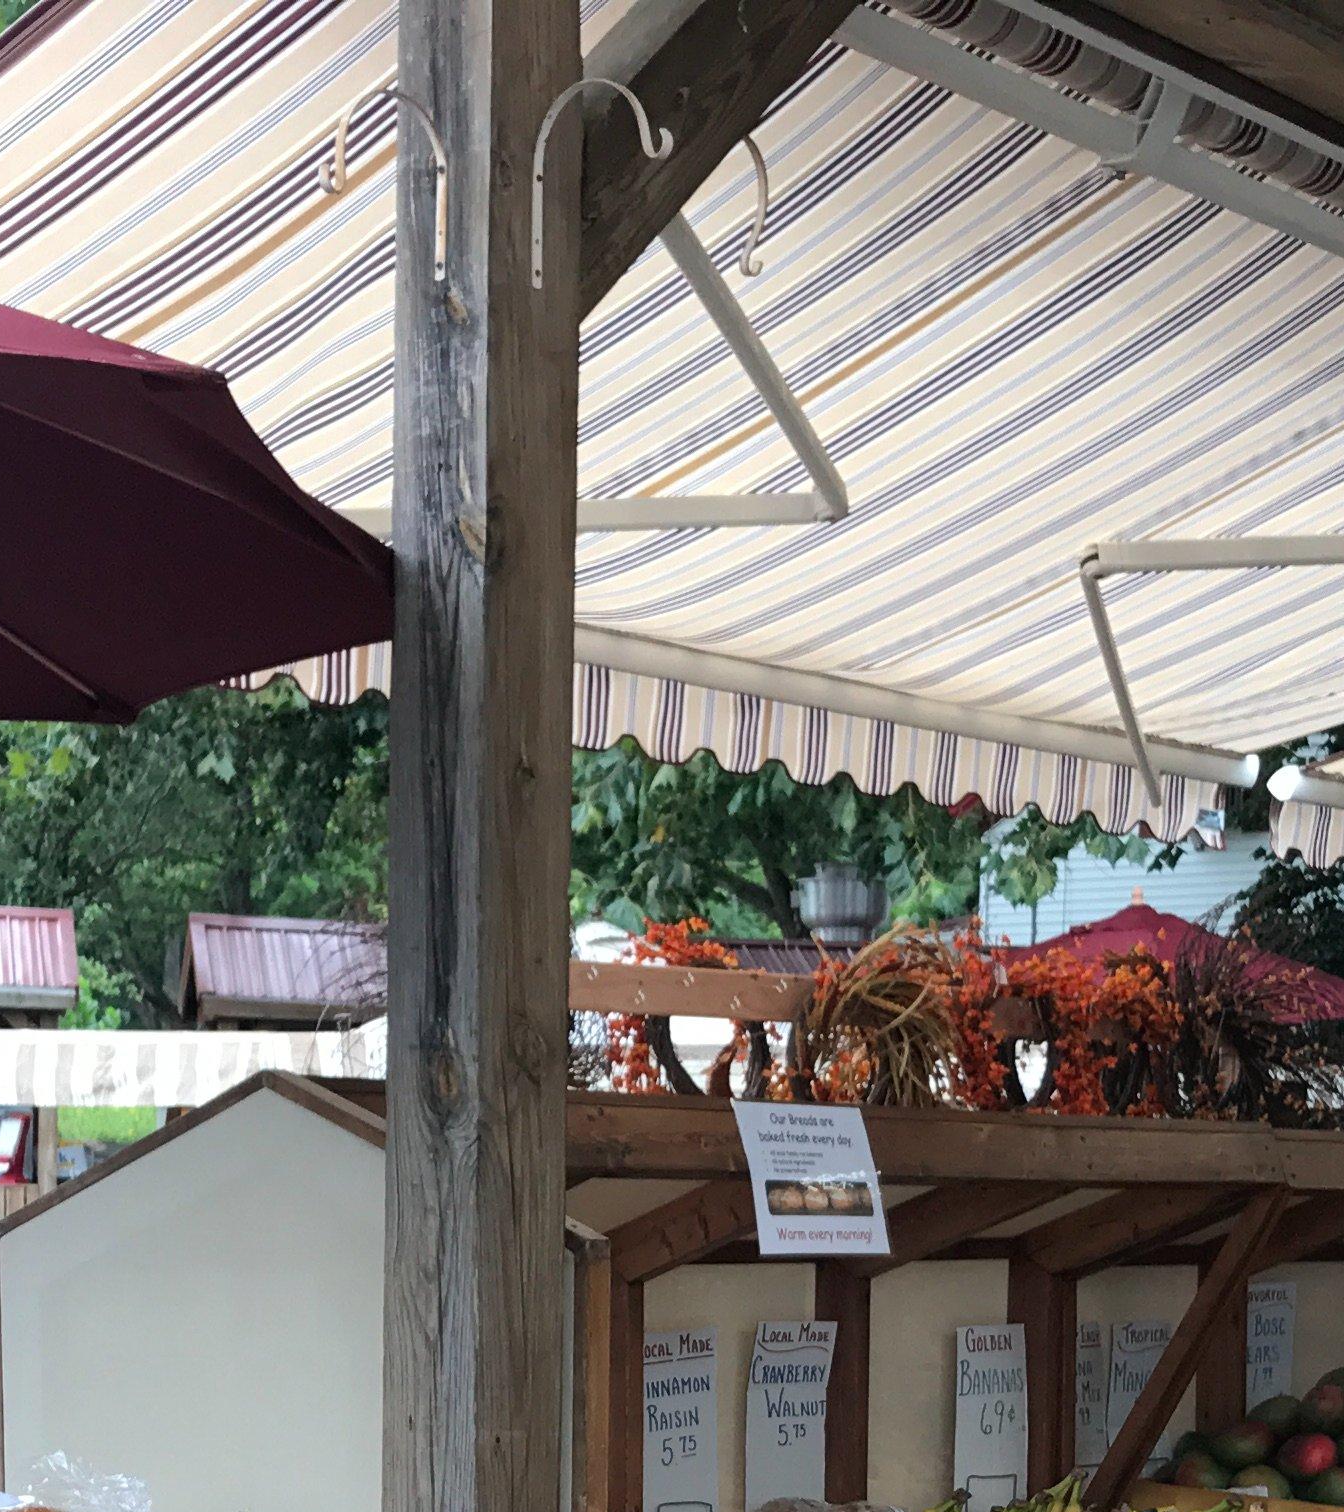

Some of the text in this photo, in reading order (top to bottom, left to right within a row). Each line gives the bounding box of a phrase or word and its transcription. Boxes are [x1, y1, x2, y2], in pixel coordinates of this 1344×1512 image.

[788, 1112, 817, 1126] Breads
[819, 1117, 834, 1127] are
[758, 1129, 785, 1143] baked
[787, 1130, 810, 1143] fresh
[812, 1135, 835, 1147] every
[776, 1226, 806, 1240] Warm
[809, 1230, 833, 1243] every
[761, 1323, 830, 1343] LOCAL MADE
[1122, 1323, 1170, 1344] TROPICAL
[1254, 1312, 1286, 1337] BOSC
[644, 1333, 714, 1358] OCAL MADE
[965, 1328, 1013, 1352] GOLDEN
[752, 1355, 826, 1385] CRANBERRY
[959, 1359, 1024, 1397] BANANAS
[646, 1376, 711, 1399] INNAMON
[764, 1387, 827, 1418] WALNUT
[647, 1405, 700, 1432] RAISIN
